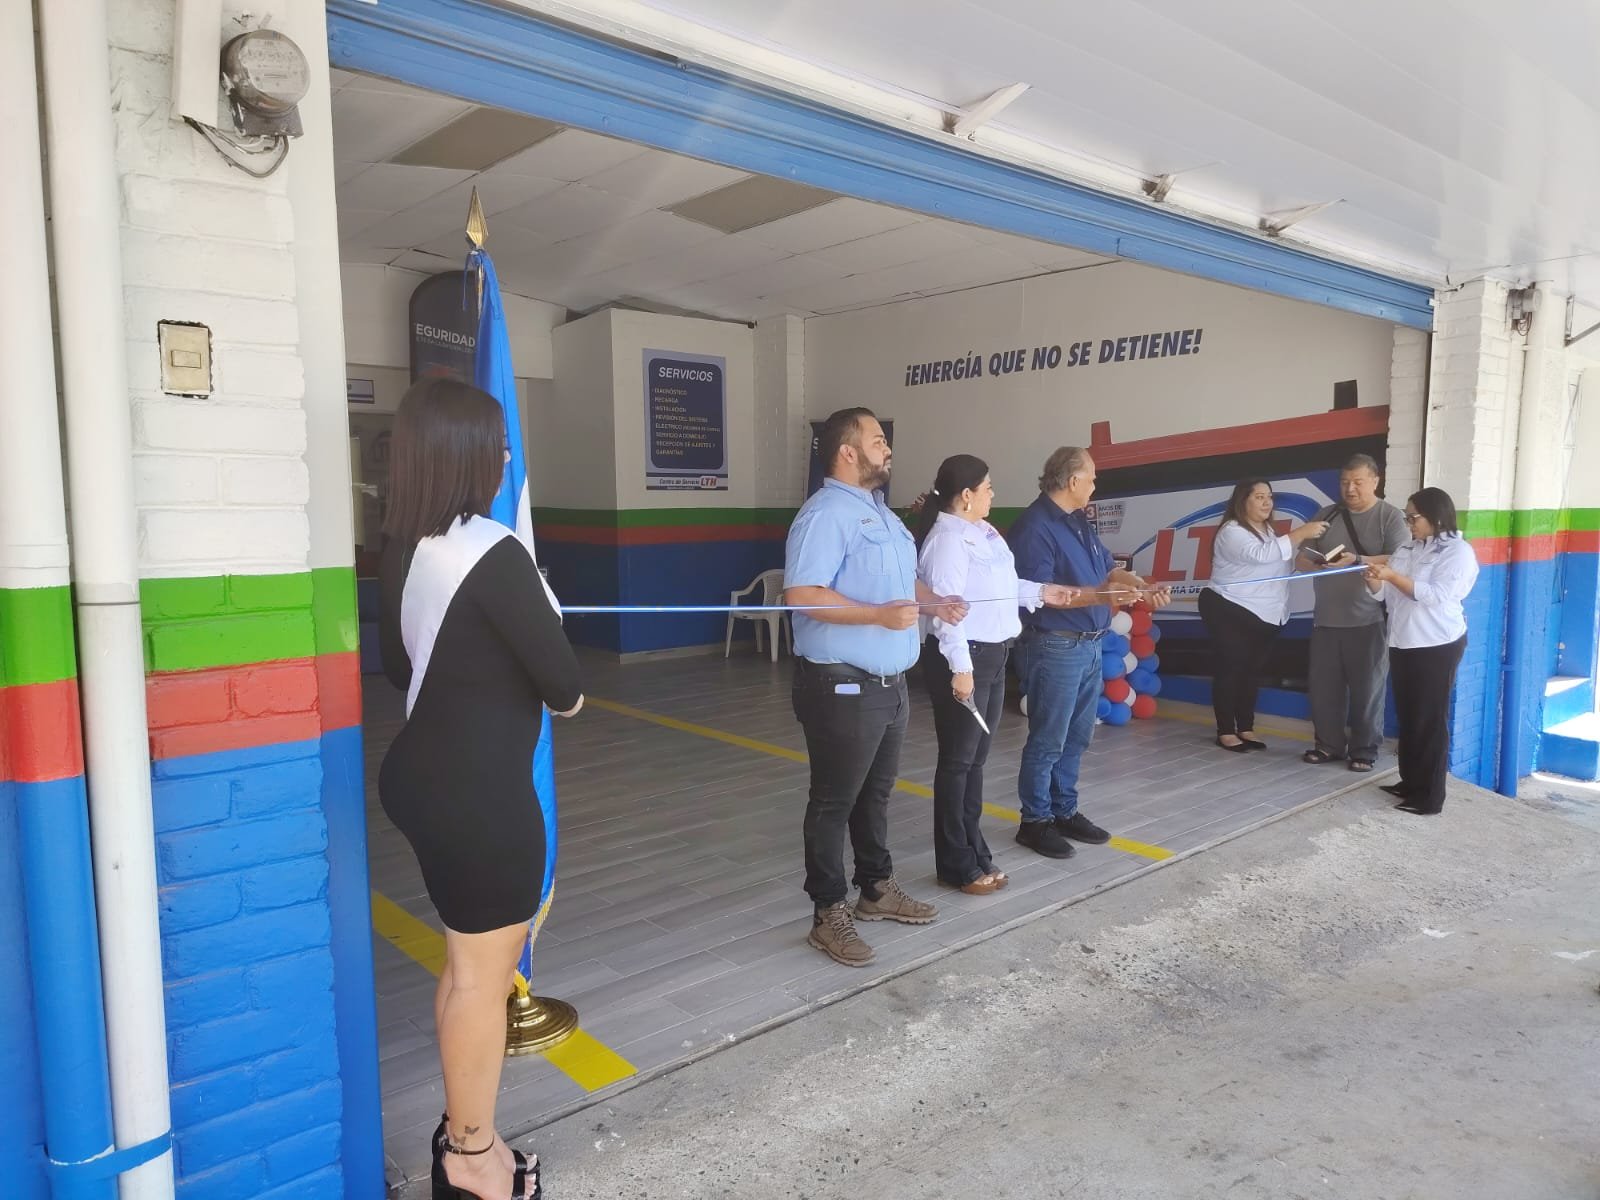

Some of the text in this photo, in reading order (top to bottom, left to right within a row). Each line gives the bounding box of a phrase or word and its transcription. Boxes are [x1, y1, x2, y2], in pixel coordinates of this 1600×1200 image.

[414, 322, 476, 348] EGURIDAD
[905, 328, 1203, 386] ¡ENERGÍA QUE NO SE DETIENE!
[658, 366, 714, 382] SERVICIOS
[701, 477, 717, 486] LTH
[1086, 506, 1095, 519] 3
